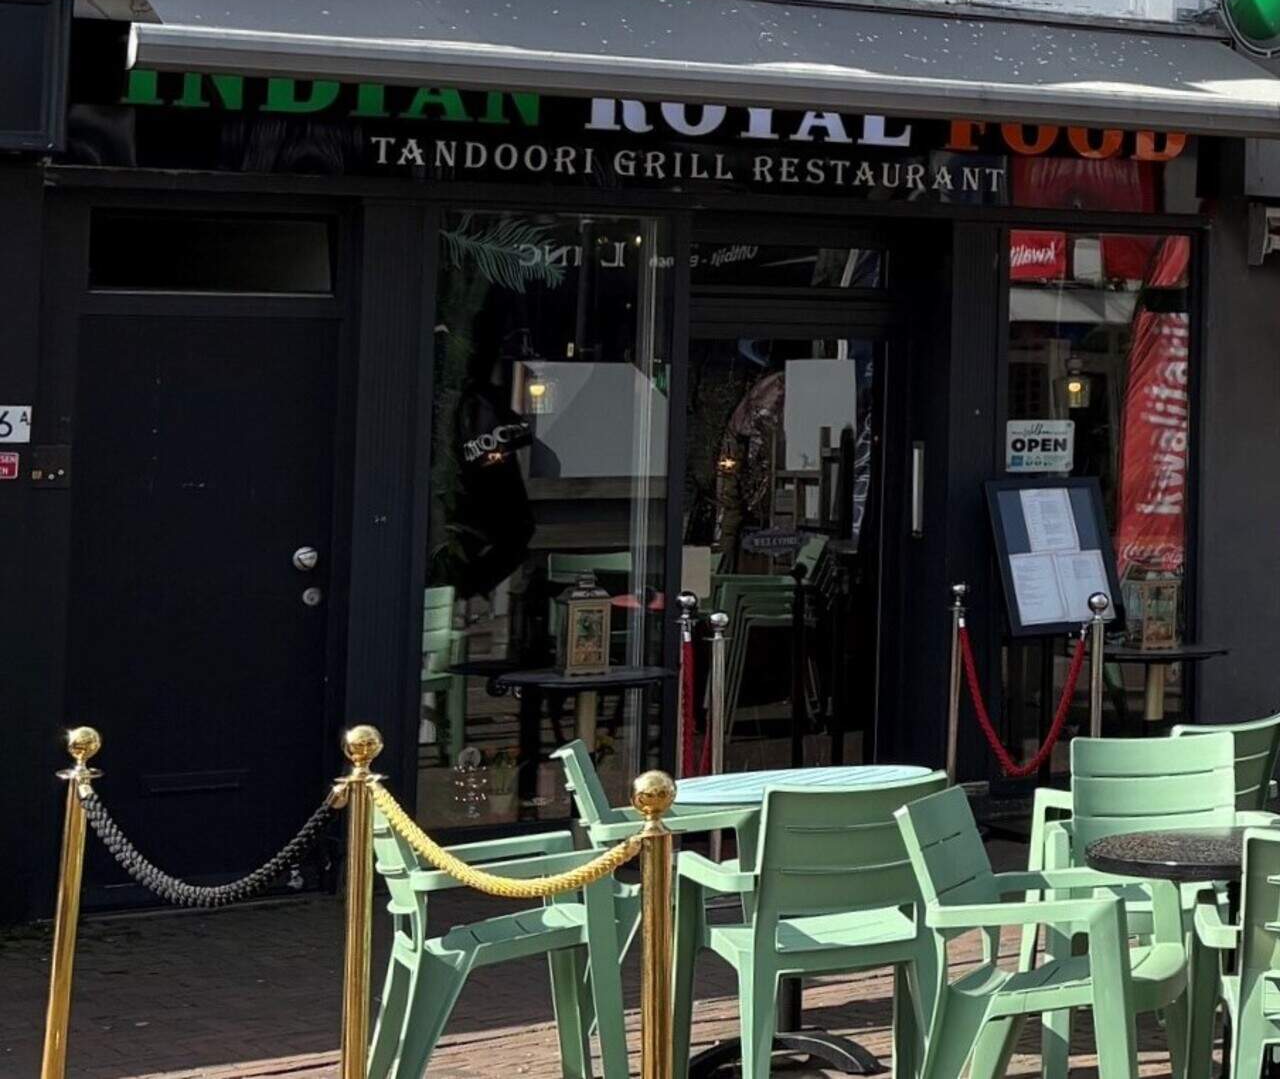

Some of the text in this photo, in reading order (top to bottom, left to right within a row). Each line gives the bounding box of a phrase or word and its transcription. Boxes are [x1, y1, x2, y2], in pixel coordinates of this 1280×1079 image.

[371, 137, 1004, 192] TANDOORI GRILL RESTAURANT
[1011, 438, 1067, 453] OPEN
